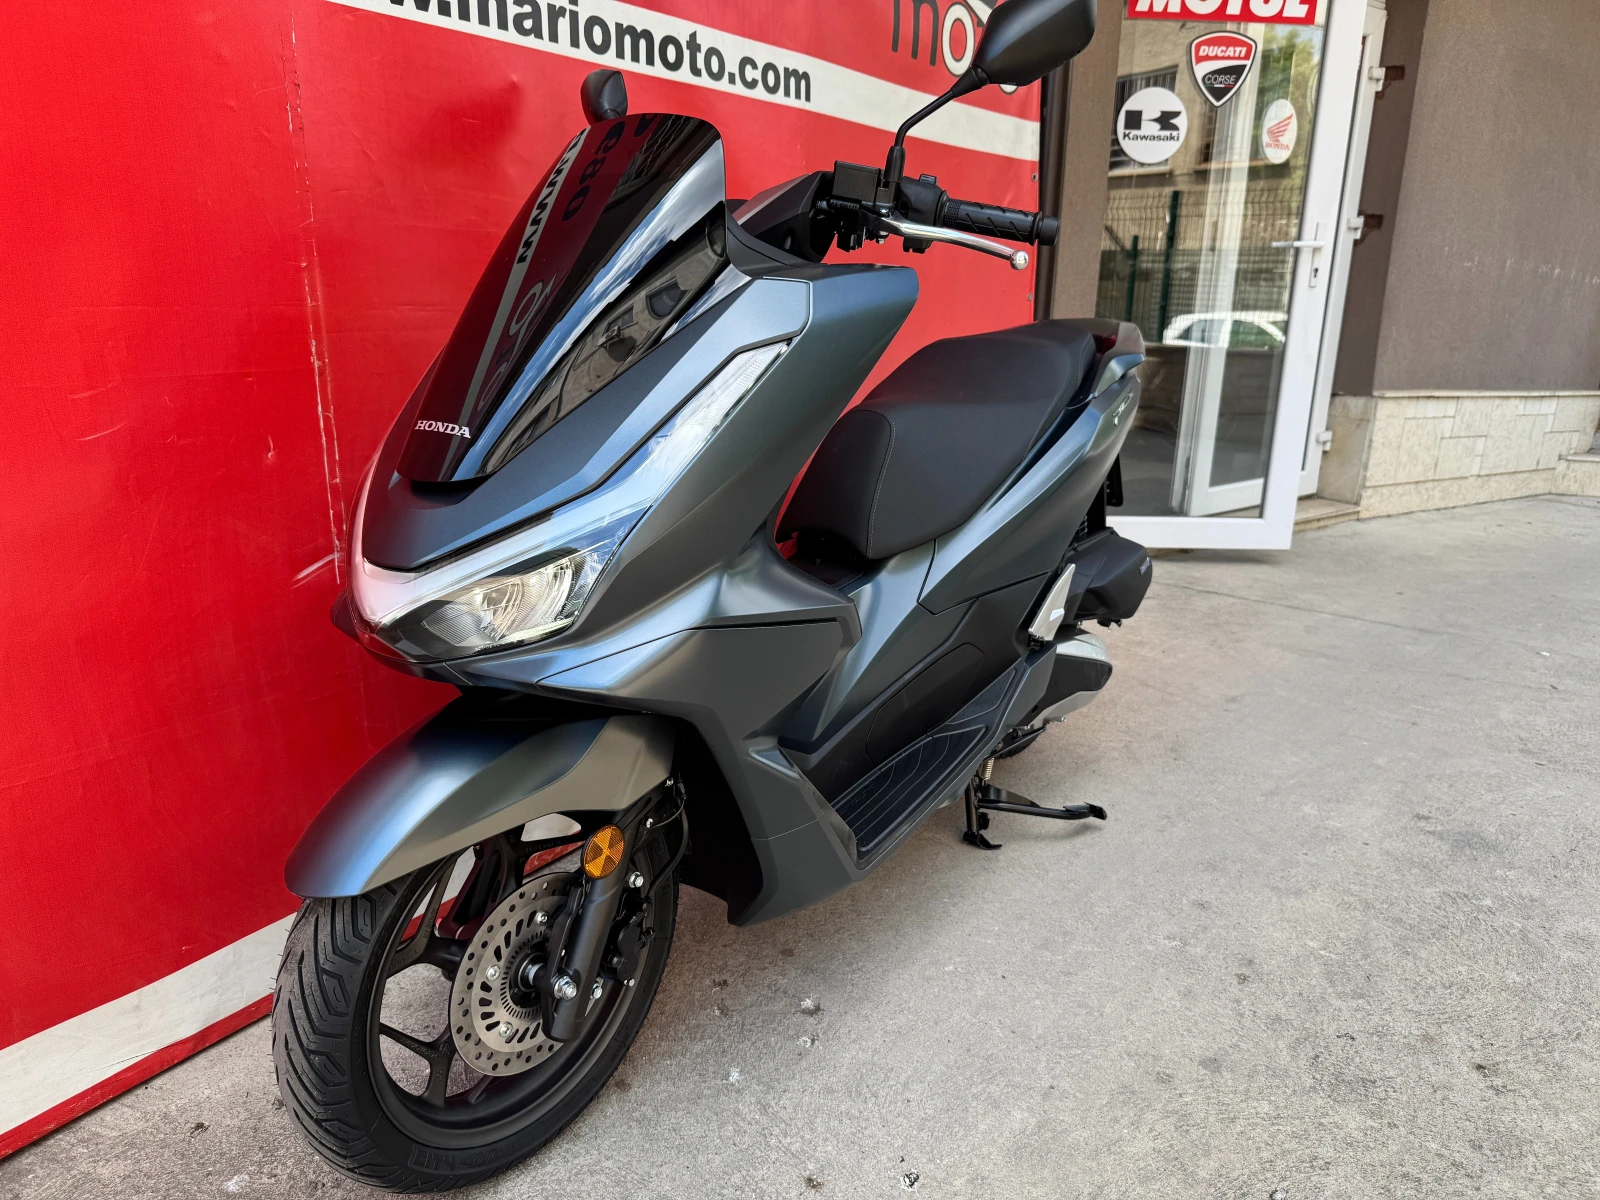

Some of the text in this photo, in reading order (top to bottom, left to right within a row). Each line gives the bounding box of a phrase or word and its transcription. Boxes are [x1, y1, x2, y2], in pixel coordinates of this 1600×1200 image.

[1198, 45, 1248, 58] DUCATI
[1204, 74, 1237, 85] CORSE
[1122, 131, 1180, 142] Kawasaki
[1265, 141, 1290, 151] HONDA
[414, 420, 472, 439] HONDA
